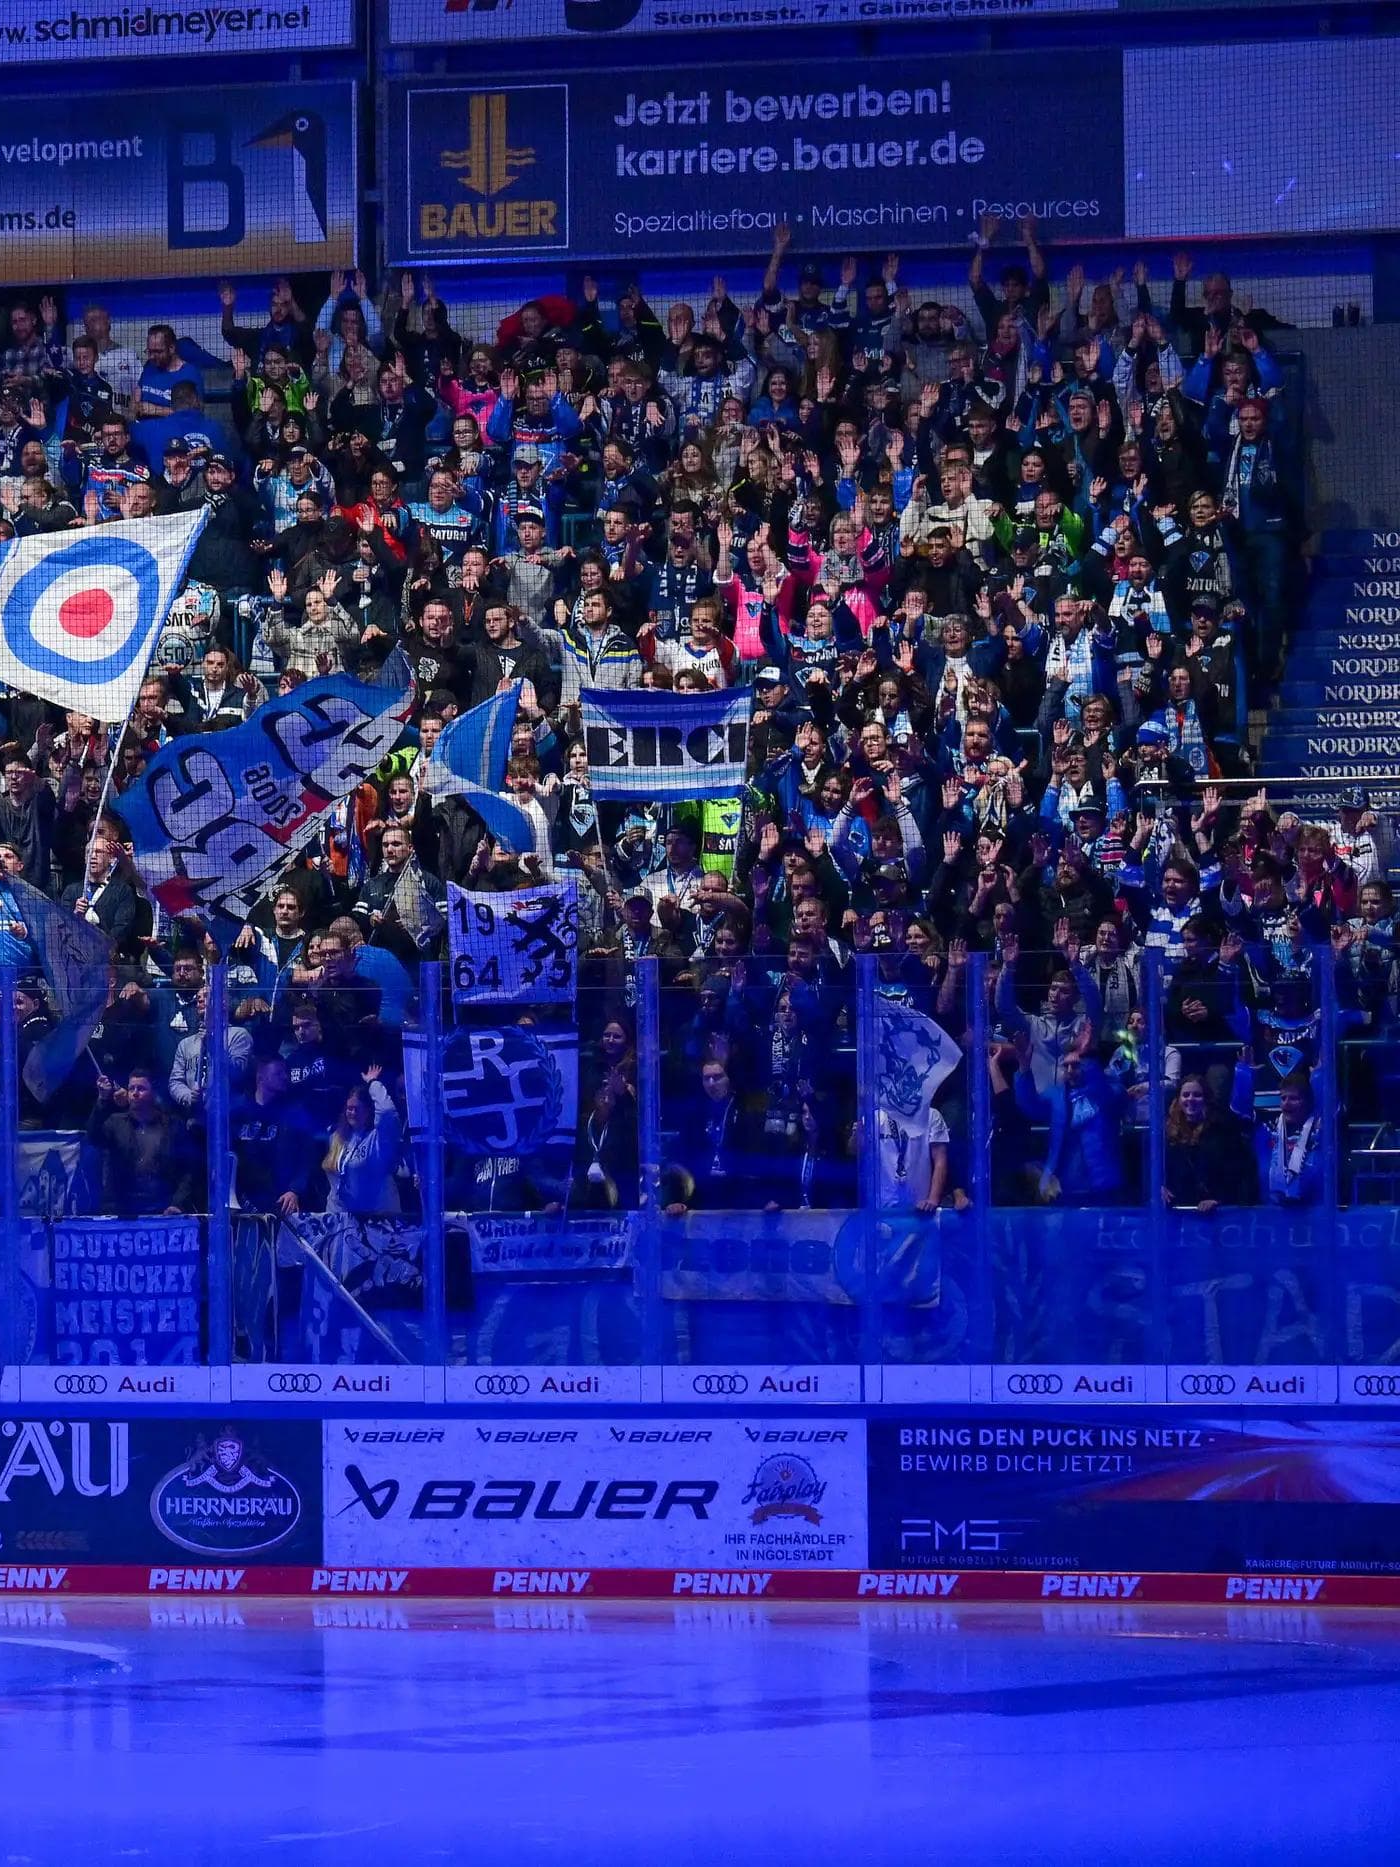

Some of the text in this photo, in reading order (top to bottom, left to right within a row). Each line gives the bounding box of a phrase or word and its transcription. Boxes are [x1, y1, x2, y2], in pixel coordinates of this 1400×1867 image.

[654, 6, 805, 28] Siemensstr.
[816, 4, 829, 18] 7
[614, 80, 952, 127] Jetzt bewerben!
[614, 130, 986, 178] karriere.bauer.de
[418, 200, 557, 240] BAUER
[614, 195, 1101, 236] Spezialtiefbau Maschinen Resources
[430, 526, 468, 542] SATURN
[452, 899, 495, 936] 19
[453, 954, 502, 988] 64
[53, 1229, 201, 1262] DEUTSCHER
[53, 1262, 197, 1295] EISHOCKEY
[53, 1298, 197, 1336] MEISTER
[118, 1376, 175, 1393] Audi
[332, 1375, 391, 1393] Audi
[540, 1375, 599, 1394] Audi
[759, 1375, 819, 1394] Audi
[1073, 1375, 1133, 1394] Audi
[1245, 1375, 1304, 1394] Audi
[899, 1428, 1202, 1447] BRING DEN PUCK INS NETZ
[899, 1455, 1134, 1473] BEWIRB DICH JETZT!
[164, 1495, 293, 1517] HERRNBRÄU
[724, 1532, 846, 1545] IHR FACHHÄNDLER
[736, 1549, 834, 1561] IN INGOLSTADT
[148, 1568, 246, 1591] PENNY
[310, 1570, 409, 1592] PENNY
[493, 1571, 591, 1594] PENNY
[673, 1572, 774, 1596] PENNY
[857, 1574, 959, 1597] PENNY
[1040, 1575, 1141, 1598] PENNY
[1225, 1577, 1325, 1601] PENNY
